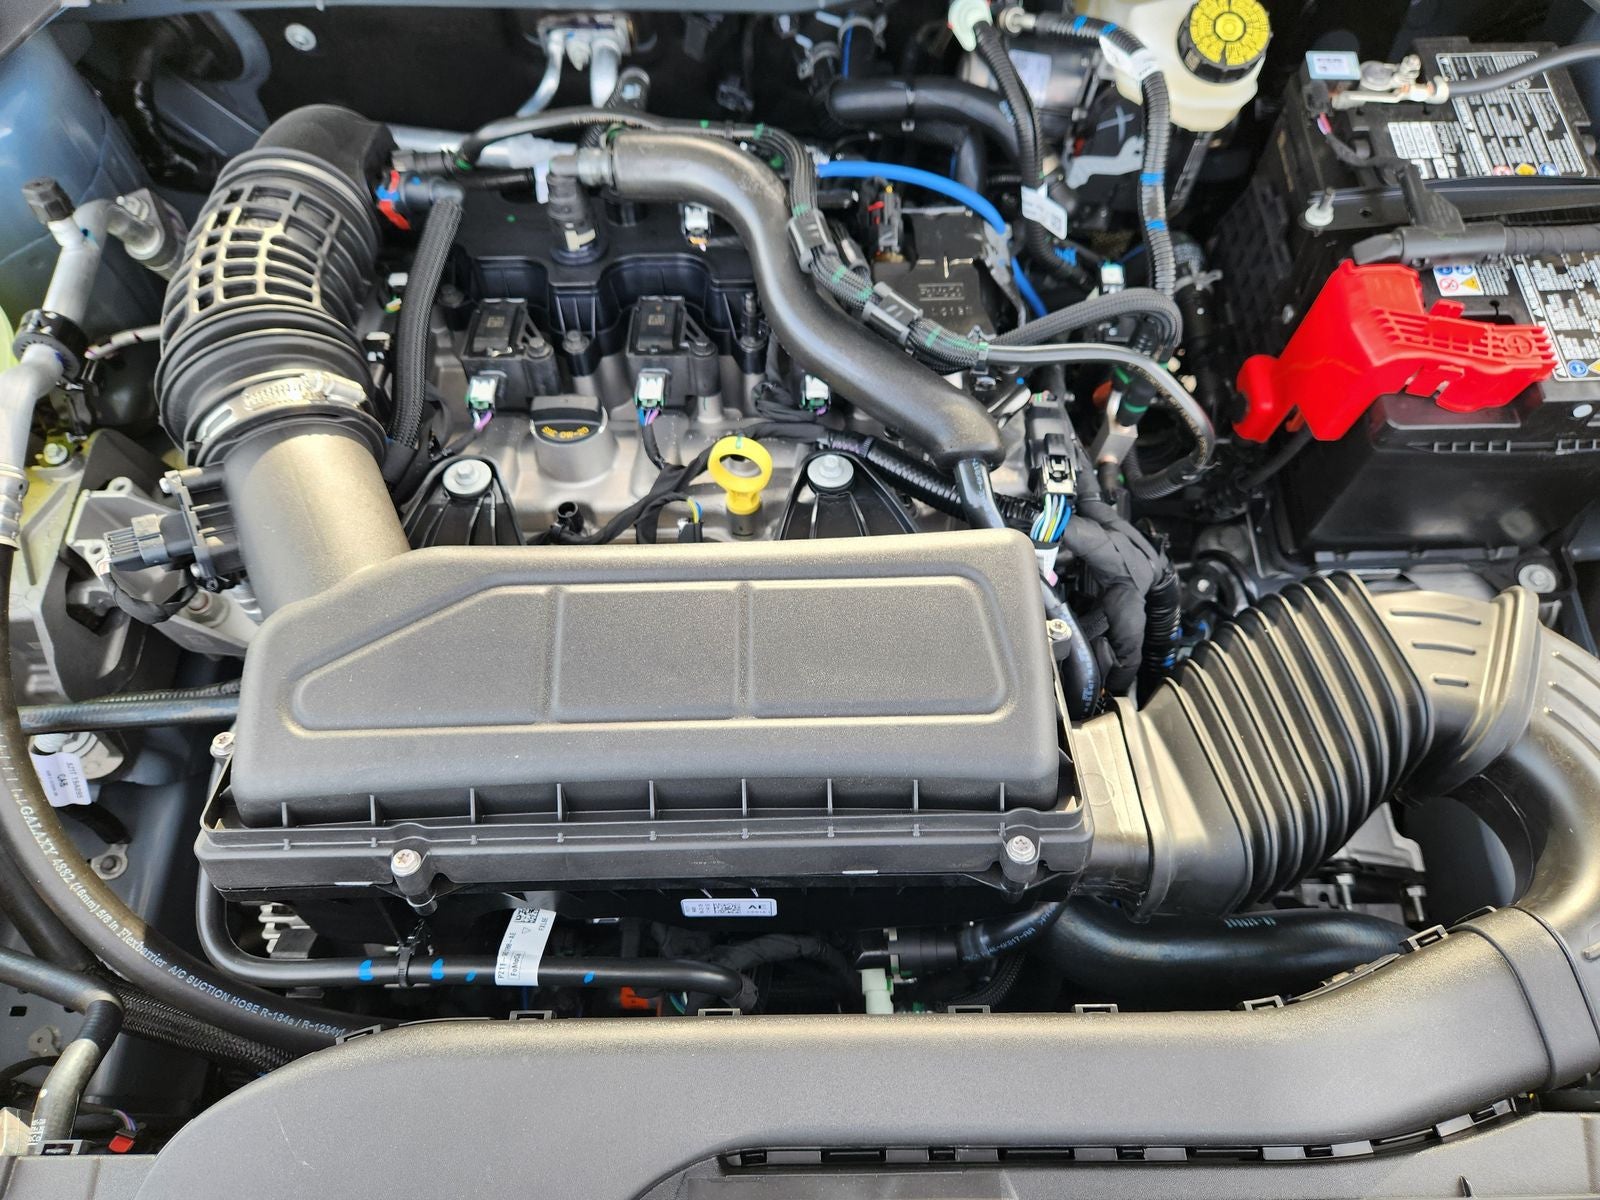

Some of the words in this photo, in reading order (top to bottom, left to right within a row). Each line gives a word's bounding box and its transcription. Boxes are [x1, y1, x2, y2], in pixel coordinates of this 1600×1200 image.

[20, 806, 59, 855] GALAXY
[52, 859, 76, 884] 4882
[69, 882, 101, 912] (16mm)
[96, 909, 113, 924] 5/8
[116, 927, 168, 968] Flexbarrier
[167, 965, 187, 979] A/C
[186, 974, 231, 1002] SUCTION
[230, 996, 261, 1014] HOSE
[260, 1008, 294, 1025] R-134a
